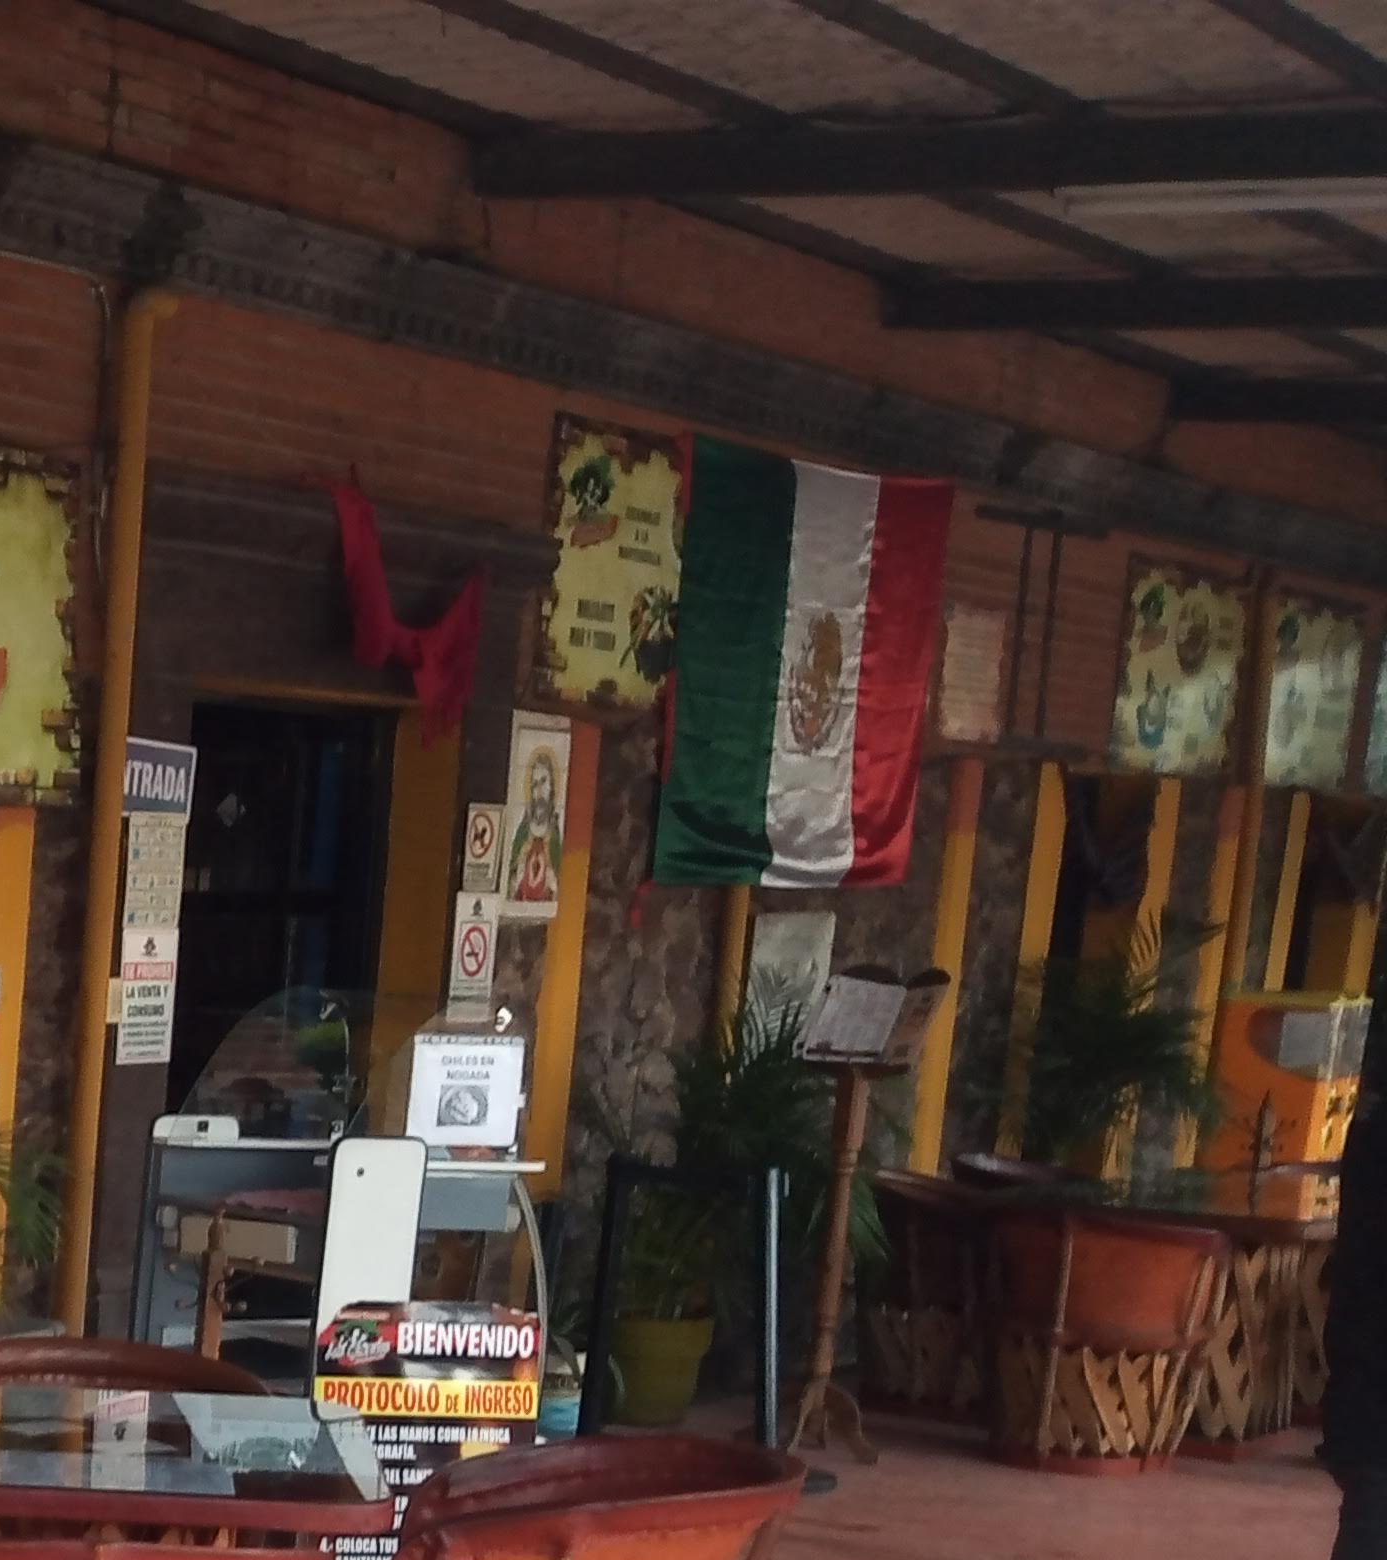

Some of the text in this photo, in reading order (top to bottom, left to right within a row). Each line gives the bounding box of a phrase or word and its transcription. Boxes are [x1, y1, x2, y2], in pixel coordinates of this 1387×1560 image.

[442, 1055, 495, 1066] CHILES EN
[397, 1321, 535, 1359] BIENVENIDO
[323, 1380, 440, 1413] PROTOCOLO
[465, 1384, 533, 1415] INGRESO
[378, 1425, 398, 1442] LAS
[399, 1425, 436, 1442] MANOS
[437, 1426, 466, 1443] COMO
[335, 1536, 377, 1553] COLOCA
